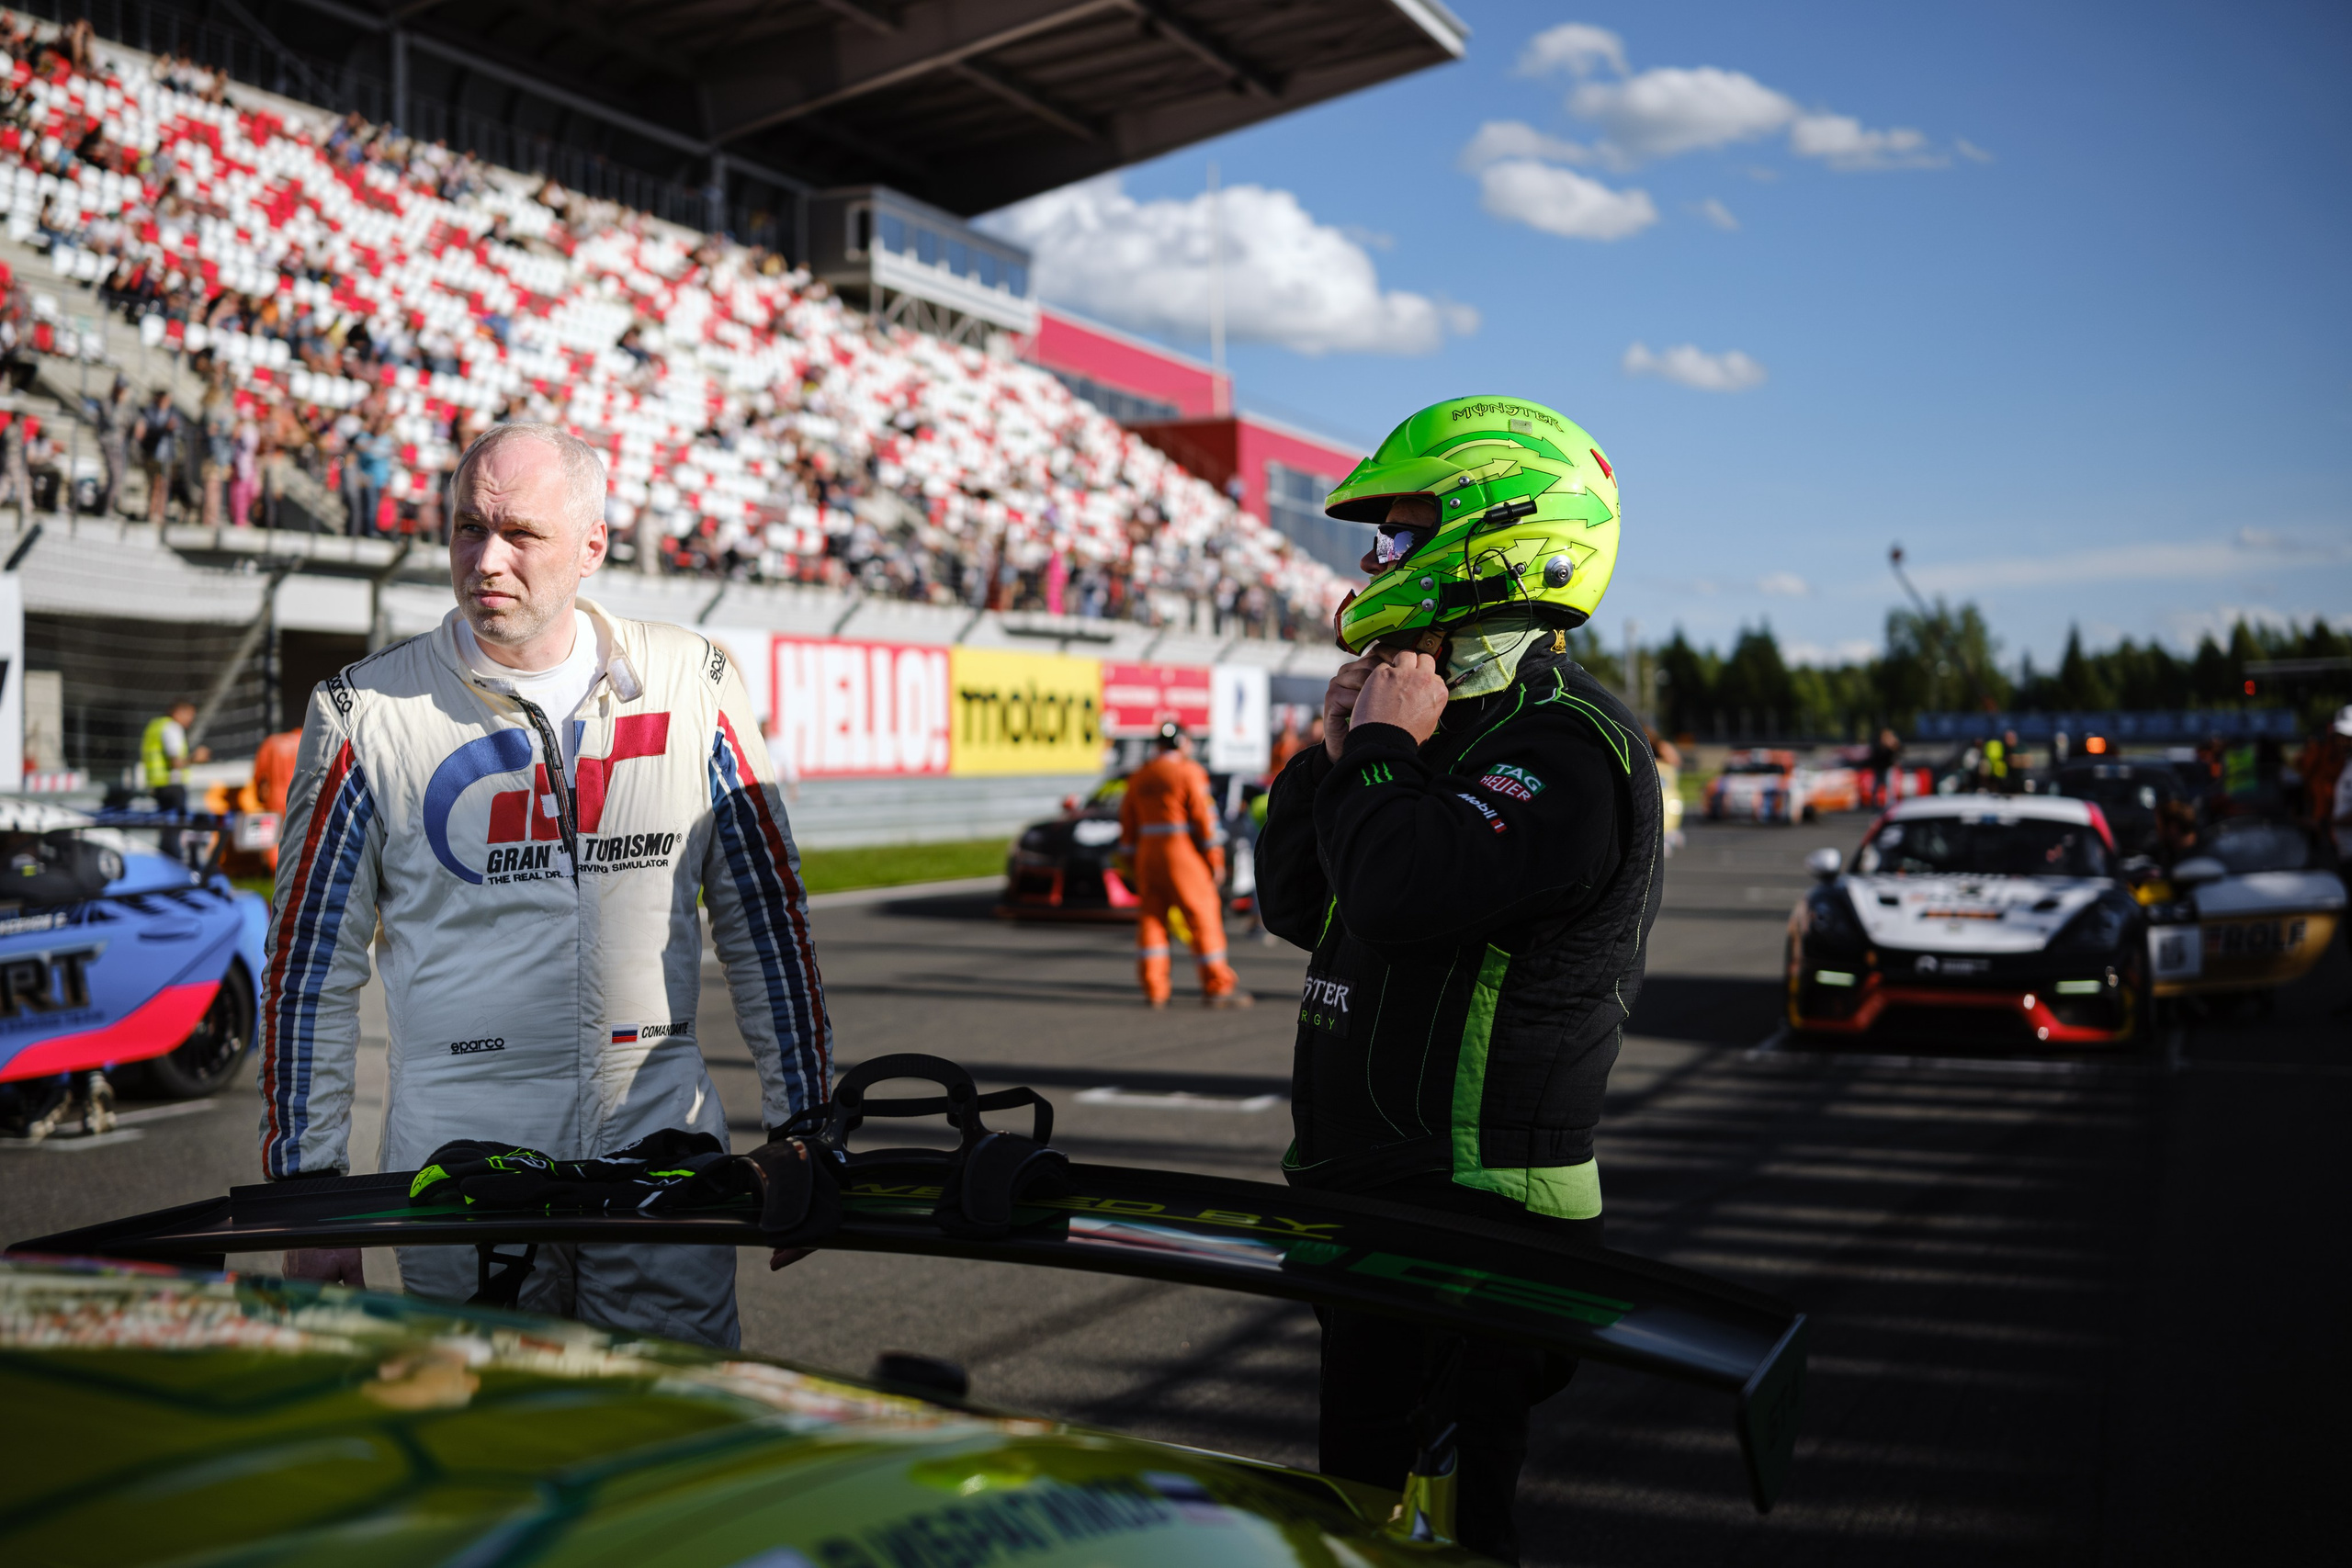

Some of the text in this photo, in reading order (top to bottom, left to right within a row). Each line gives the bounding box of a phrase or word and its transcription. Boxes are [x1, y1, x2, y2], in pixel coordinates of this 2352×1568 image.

[1452, 402, 1565, 433] MONSTER
[777, 642, 948, 772] HELLO!
[1480, 775, 1532, 801] HEUER
[1496, 763, 1542, 792] TAG
[1456, 793, 1498, 819] Mobil
[487, 844, 551, 874] GRAN
[488, 874, 511, 885] THE
[513, 872, 544, 882] REAL
[612, 859, 669, 872] SIMULATOR
[0, 942, 108, 1020] RT
[1301, 1010, 1335, 1030] RGY
[450, 1037, 505, 1055] sparco
[1196, 1209, 1345, 1232] BY
